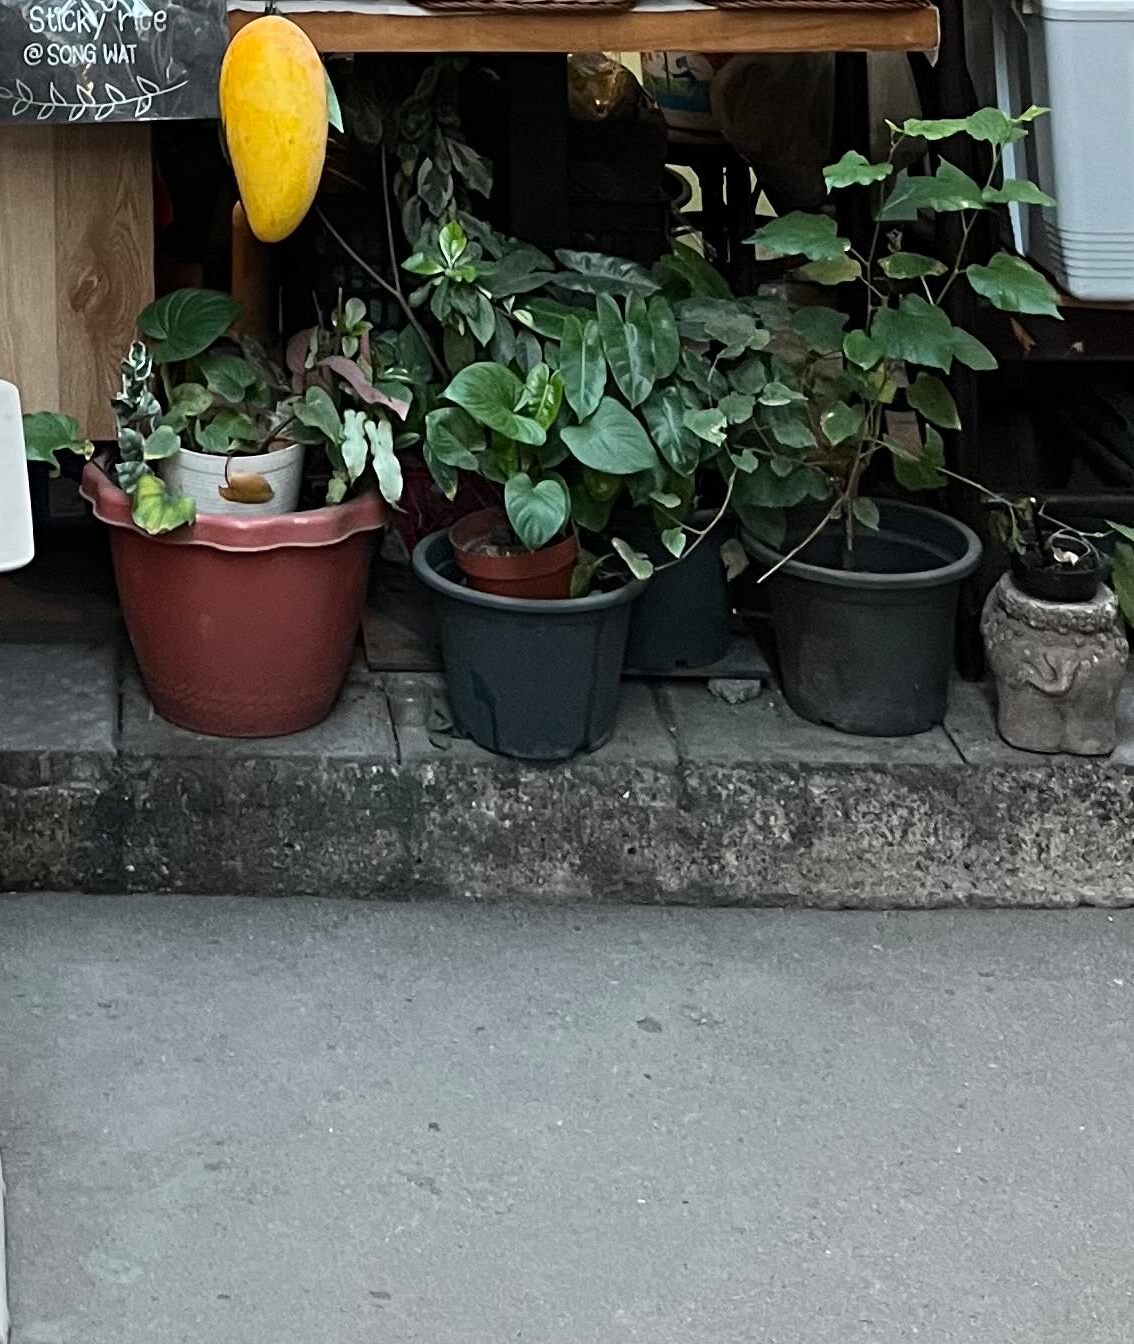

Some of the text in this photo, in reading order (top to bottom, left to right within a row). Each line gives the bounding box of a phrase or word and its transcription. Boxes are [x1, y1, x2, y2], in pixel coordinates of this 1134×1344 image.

[29, 5, 167, 41] Sticky rice
[103, 43, 138, 65] WAT
